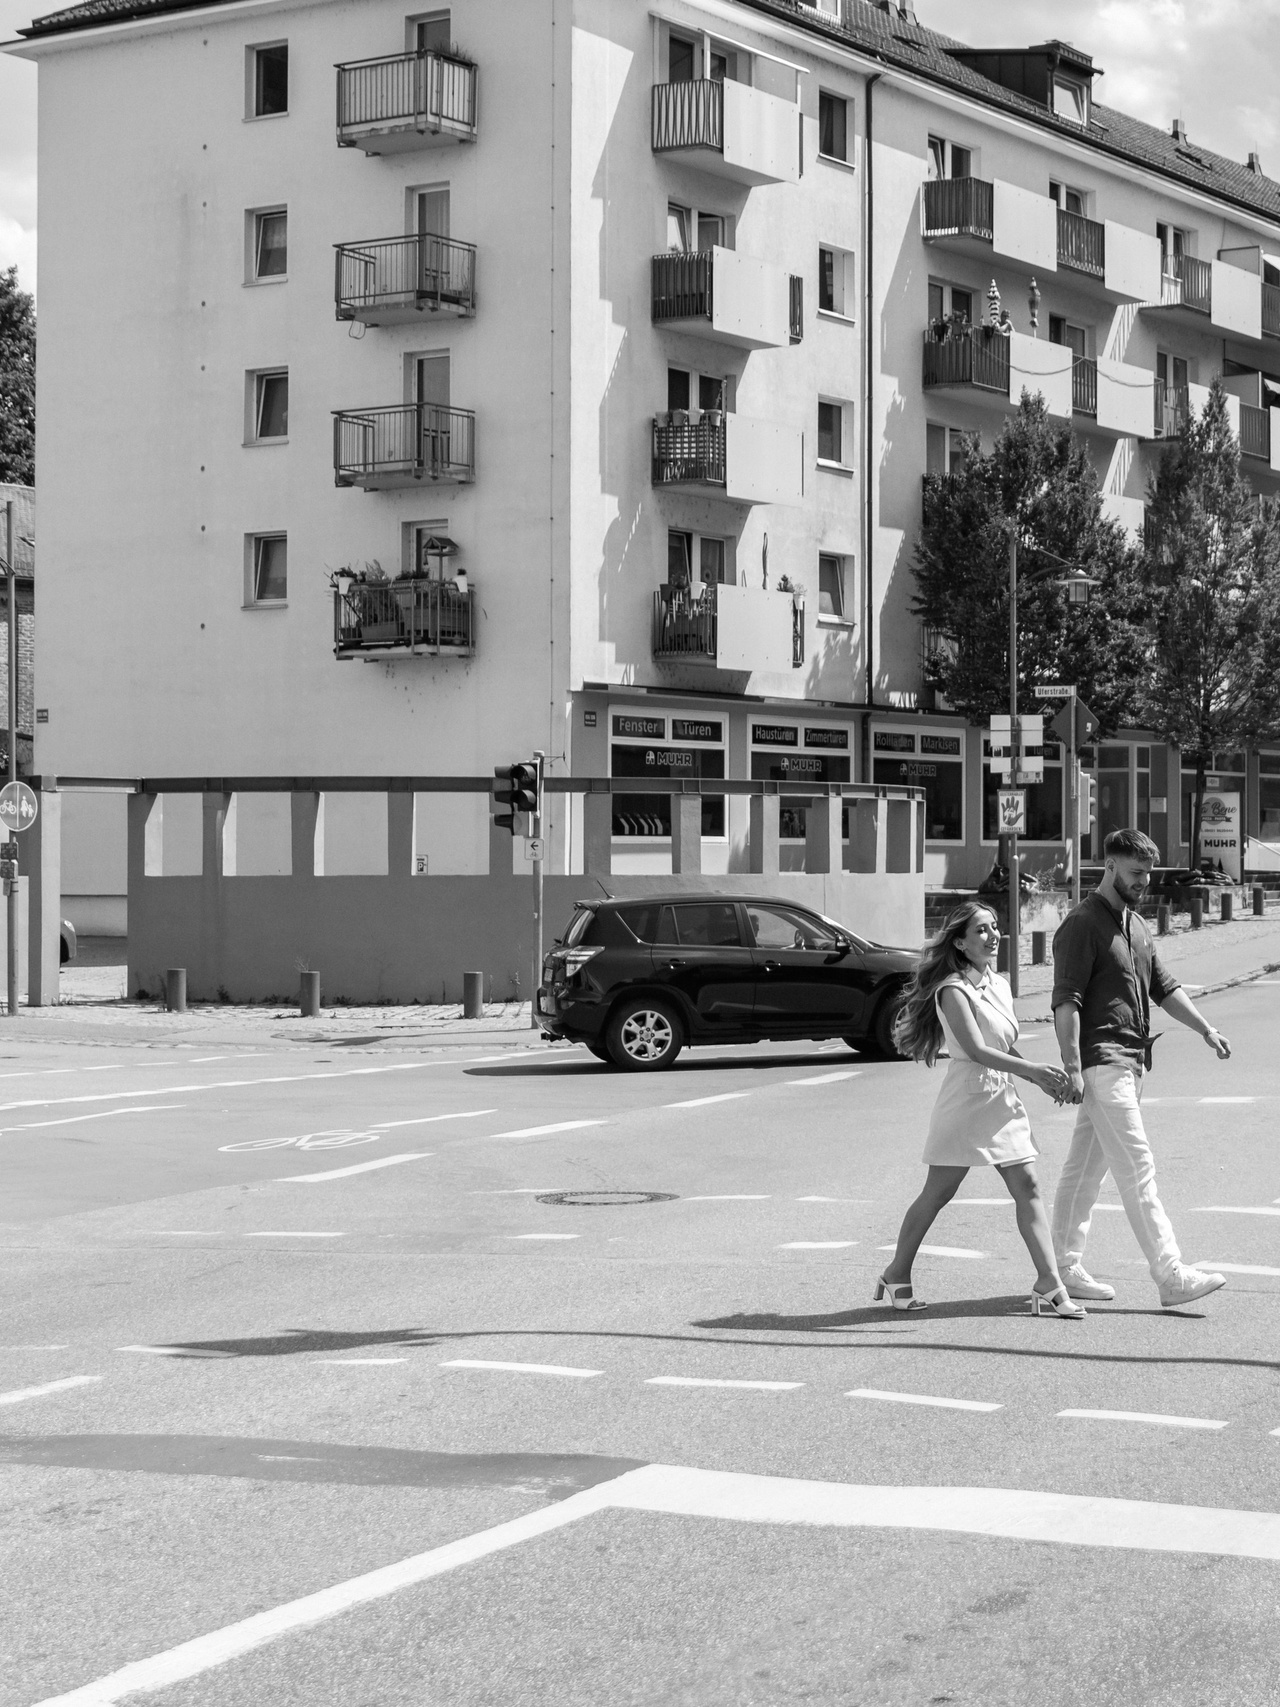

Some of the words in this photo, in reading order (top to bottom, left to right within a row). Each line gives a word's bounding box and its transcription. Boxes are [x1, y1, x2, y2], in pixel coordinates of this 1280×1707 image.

[620, 718, 658, 733] Fenster
[683, 721, 712, 736] Türen
[756, 726, 794, 741] Haustüren
[806, 730, 846, 744] Zimmertüren
[923, 736, 958, 750] Markisen
[657, 752, 692, 766] MUHR
[791, 758, 822, 772] MUHR
[909, 764, 936, 776] MUHR
[1204, 839, 1237, 848] MUHR
